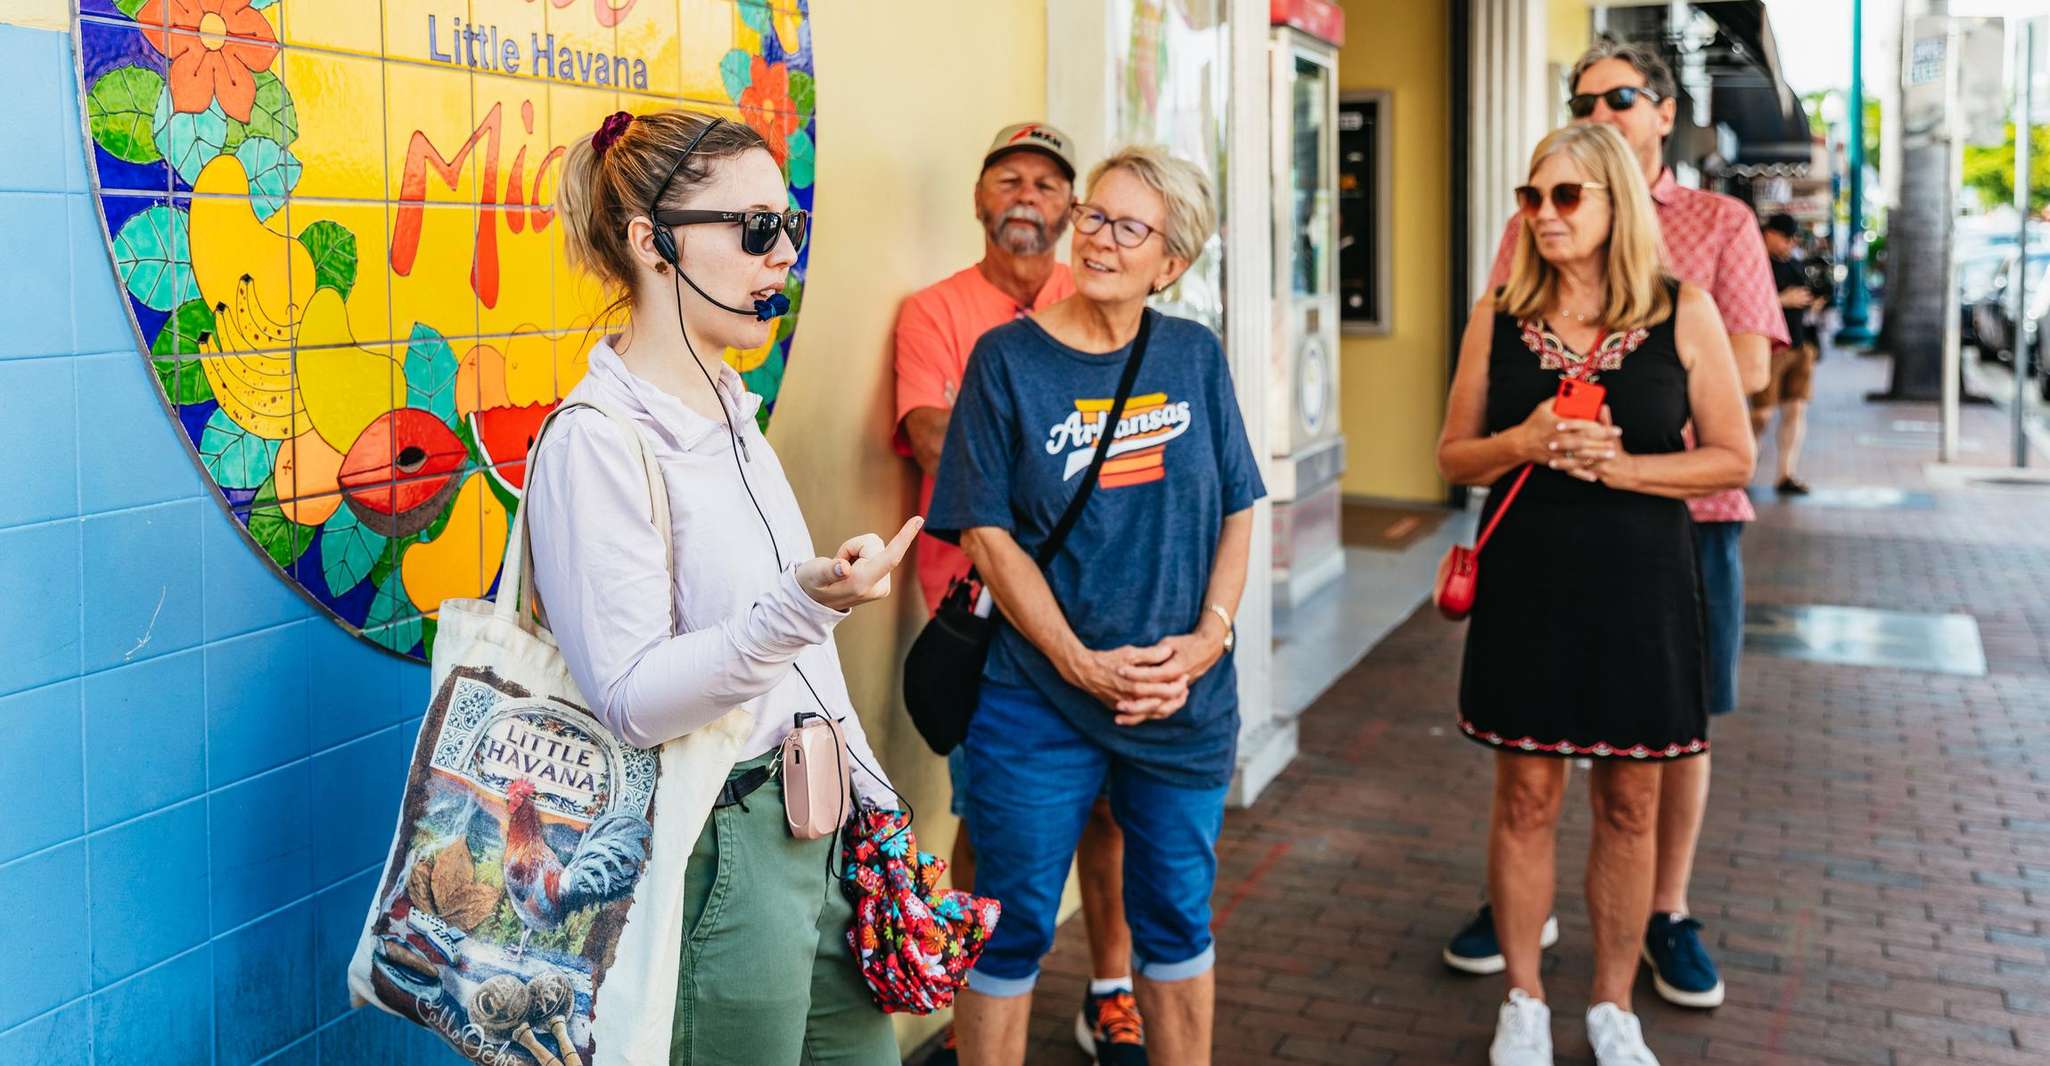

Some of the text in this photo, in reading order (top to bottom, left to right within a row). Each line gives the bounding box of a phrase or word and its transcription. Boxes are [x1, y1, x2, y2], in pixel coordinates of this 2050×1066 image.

[428, 14, 521, 74] Little
[531, 32, 649, 90] Havana
[487, 739, 595, 792] HAVANA
[507, 724, 594, 768] LITTLE
[415, 992, 461, 1045] Calle
